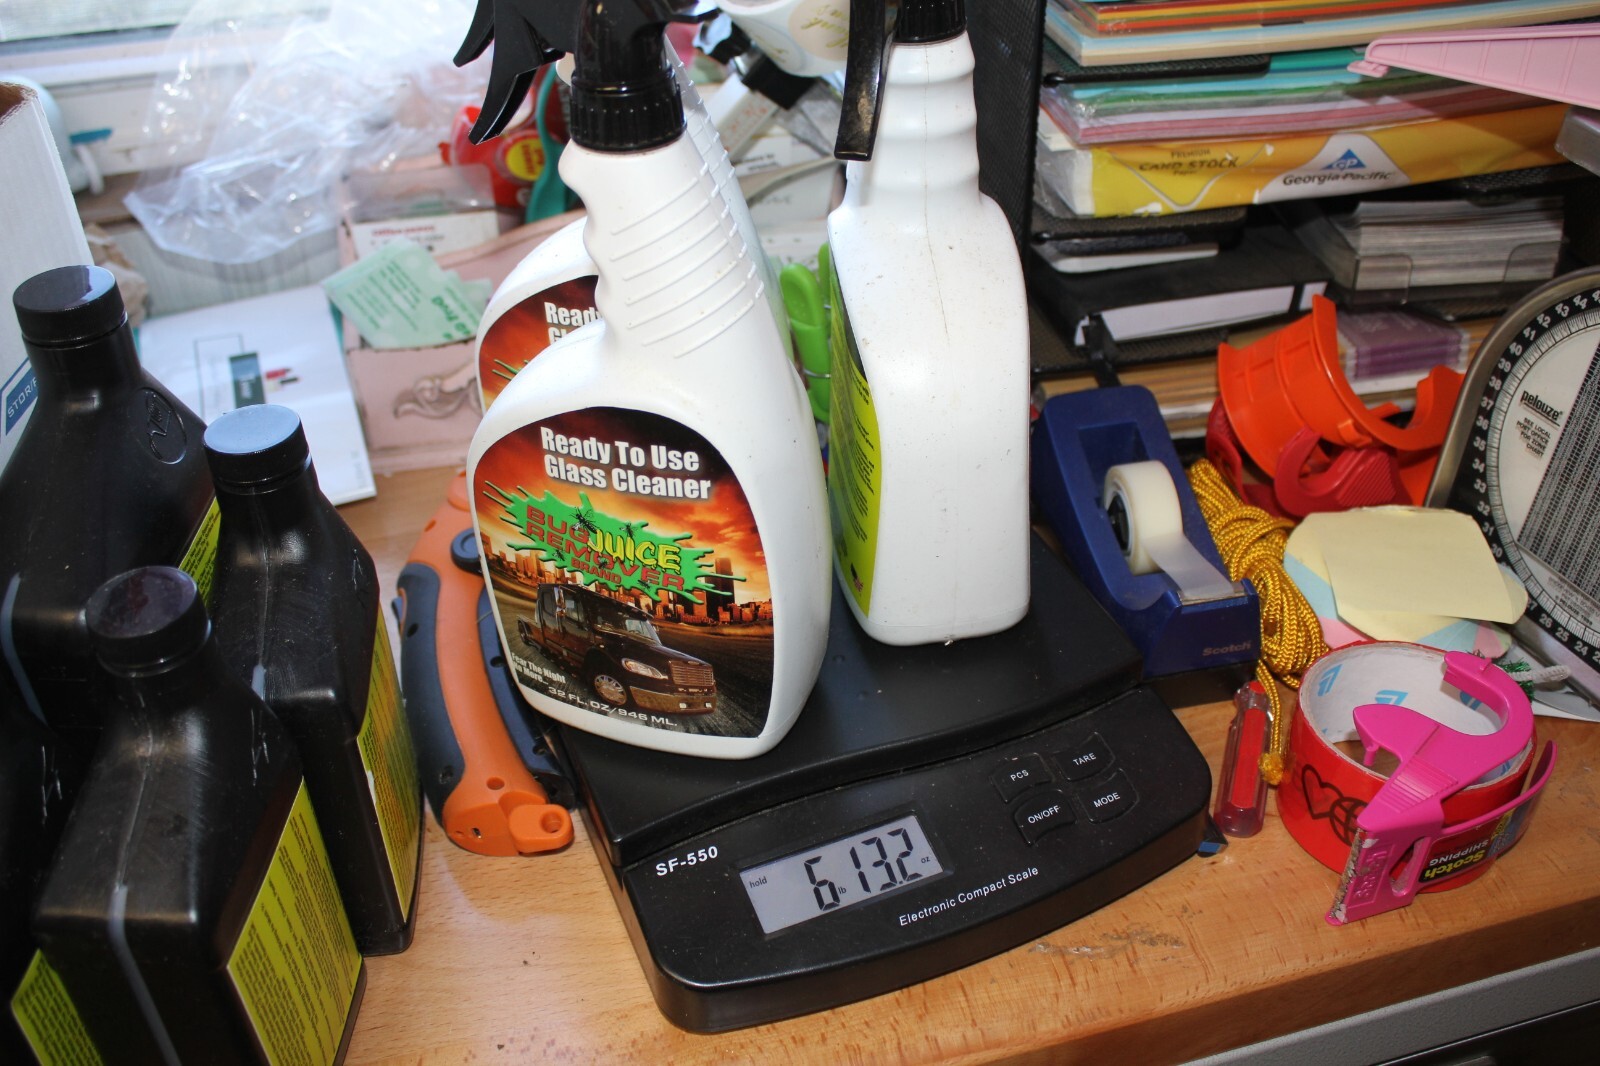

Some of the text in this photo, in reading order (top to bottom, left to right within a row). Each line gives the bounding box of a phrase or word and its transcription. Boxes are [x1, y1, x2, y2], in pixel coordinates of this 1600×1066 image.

[1189, 156, 1239, 169] STOCK
[1573, 294, 1588, 310] 44
[1555, 303, 1570, 317] 43
[1536, 313, 1551, 328] 42
[1523, 327, 1536, 341] 41
[1508, 342, 1523, 356] 40
[1498, 358, 1512, 373] 39
[1489, 376, 1502, 391] 38
[1480, 396, 1494, 411] 37
[1475, 415, 1489, 430] 36
[1517, 421, 1549, 445] POST OFFICE
[1521, 431, 1532, 441] FOR
[1534, 425, 1551, 439] LOCAL
[541, 427, 699, 471] Ready To Use
[1473, 436, 1486, 450] 35
[1472, 458, 1486, 473] 34
[544, 454, 711, 499] Glass Cleaner
[1474, 478, 1487, 494] 33
[1477, 501, 1490, 516] 32
[1482, 521, 1495, 536] 31
[527, 505, 681, 574] BUG JUICE
[526, 521, 684, 591] REMOVER
[571, 557, 622, 585] BRAND
[1539, 613, 1553, 628] 26
[1556, 627, 1570, 642] 25
[1202, 641, 1251, 657] Scotch
[1574, 640, 1589, 656] 24
[527, 661, 543, 675] The
[543, 667, 567, 684] Night
[548, 686, 567, 699] 32
[1072, 752, 1097, 767] TARE
[1010, 769, 1029, 782] PCS
[1093, 792, 1121, 808] MODE
[1027, 805, 1061, 825] ON/OFF
[655, 845, 719, 877] SF-550
[1429, 840, 1489, 867] SHIPPING
[1424, 850, 1486, 879] Scotch
[749, 875, 768, 890] hold
[803, 855, 841, 912] 6
[837, 885, 847, 896] lb
[920, 855, 931, 865] oz
[898, 866, 1040, 927] Electronic Compact Scale
